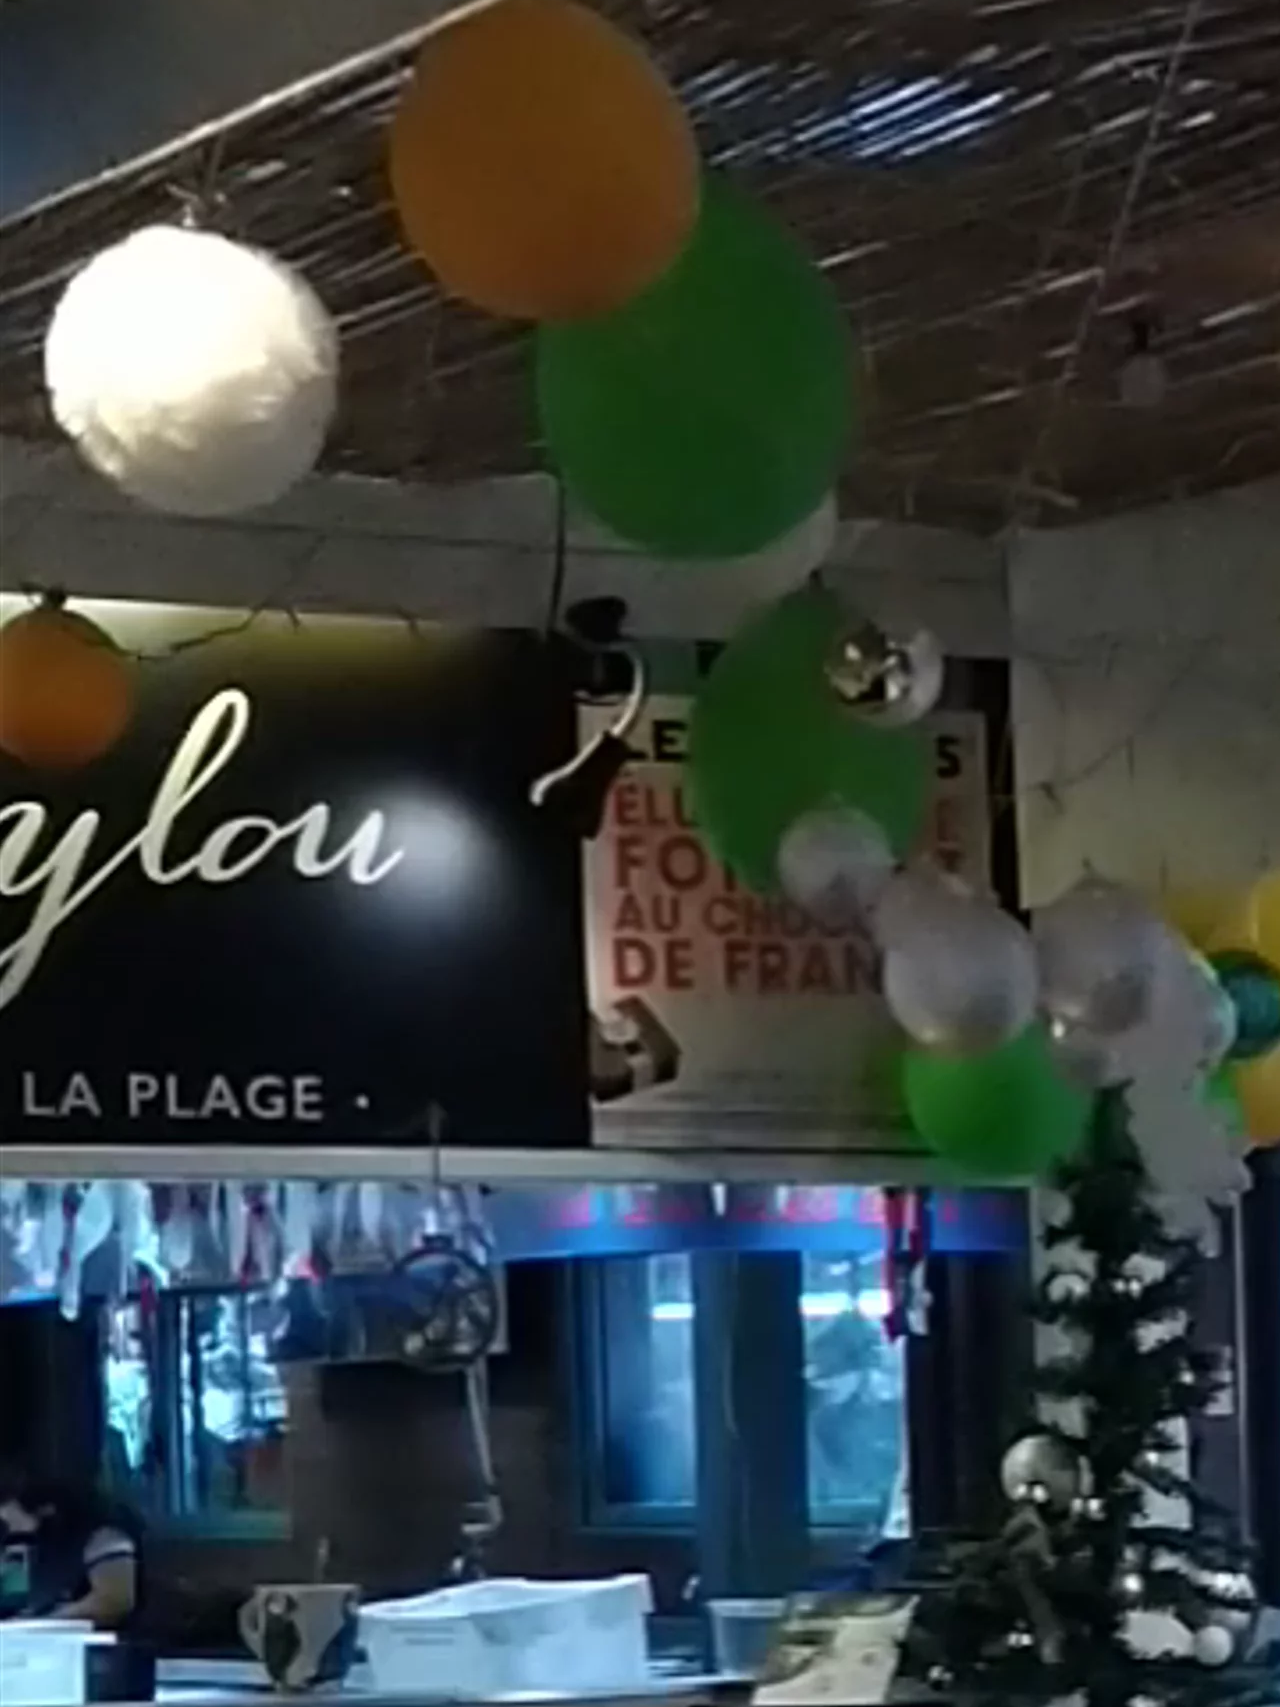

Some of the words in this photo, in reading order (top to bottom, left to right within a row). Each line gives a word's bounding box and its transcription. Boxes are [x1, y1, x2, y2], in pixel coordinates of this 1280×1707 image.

[613, 833, 738, 892] FO
[613, 893, 684, 935] AU
[612, 936, 696, 991] DE
[21, 1071, 103, 1118] LA
[127, 1073, 326, 1121] PLAGE
